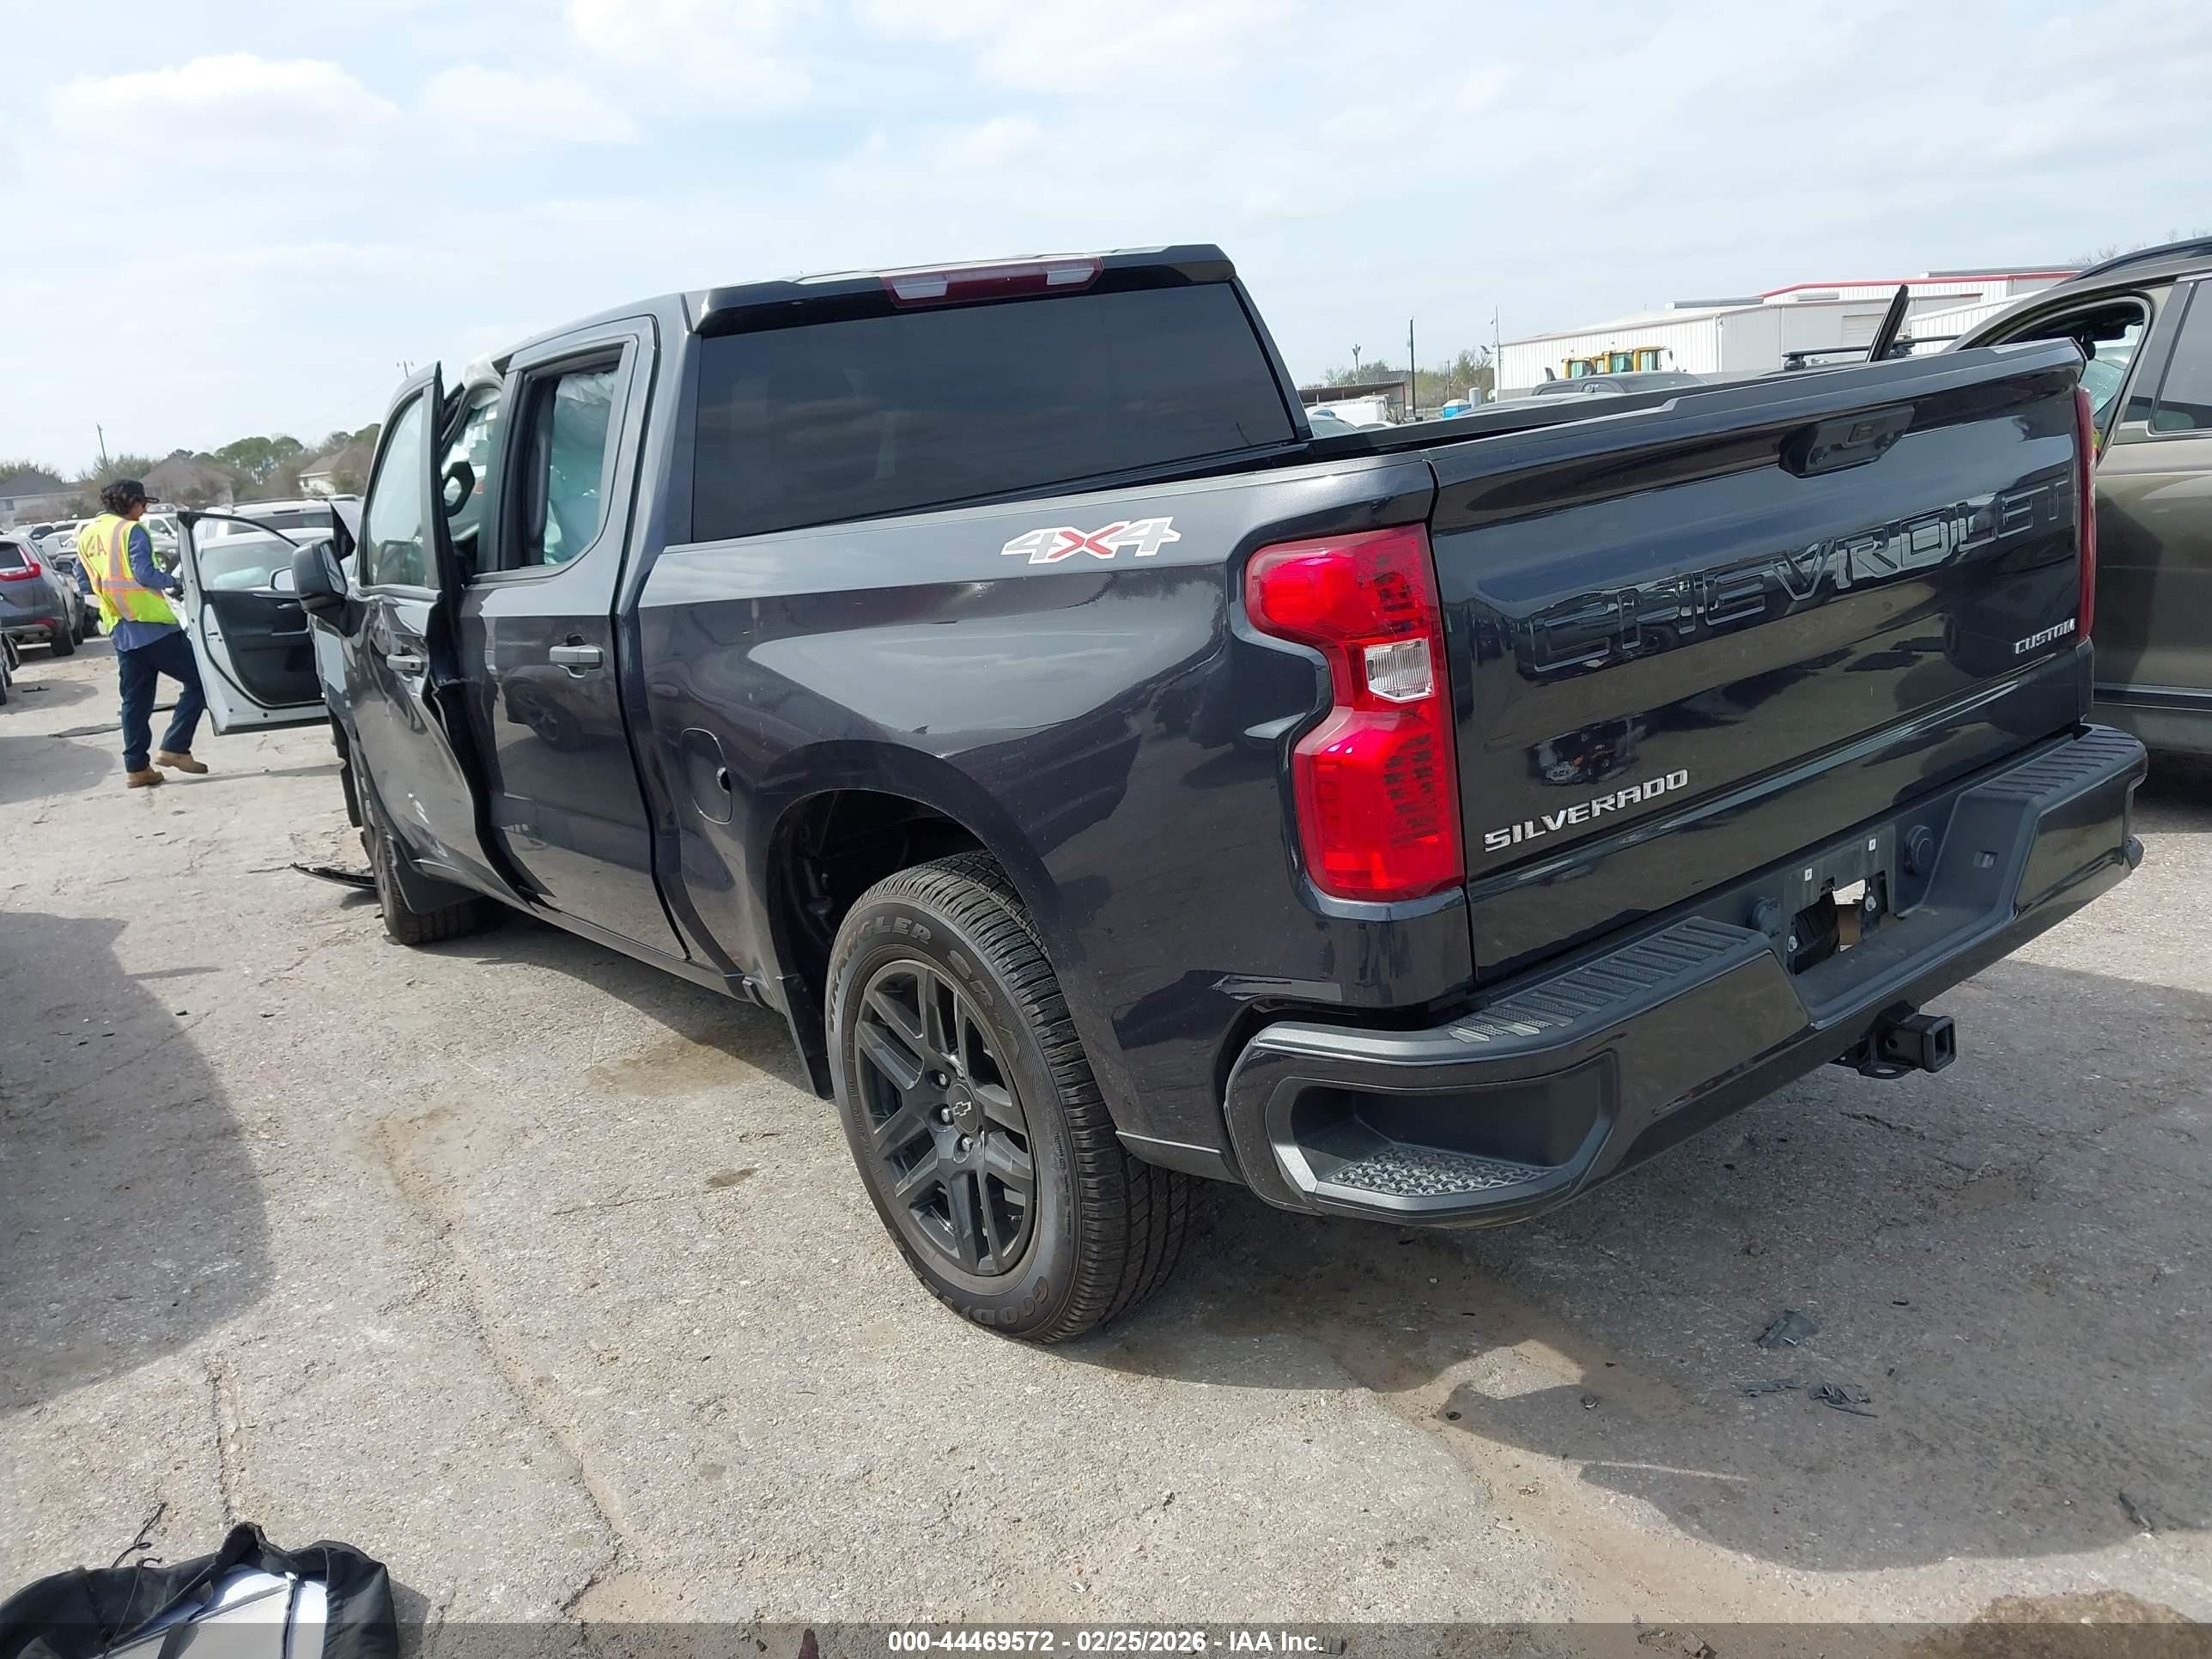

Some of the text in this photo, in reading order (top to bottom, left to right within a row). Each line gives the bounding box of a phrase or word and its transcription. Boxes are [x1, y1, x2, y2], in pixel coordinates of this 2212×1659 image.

[1531, 477, 2069, 672] CHEVROLET
[2014, 617, 2075, 654] CUSTOM
[1484, 769, 1689, 854] SILVERADO
